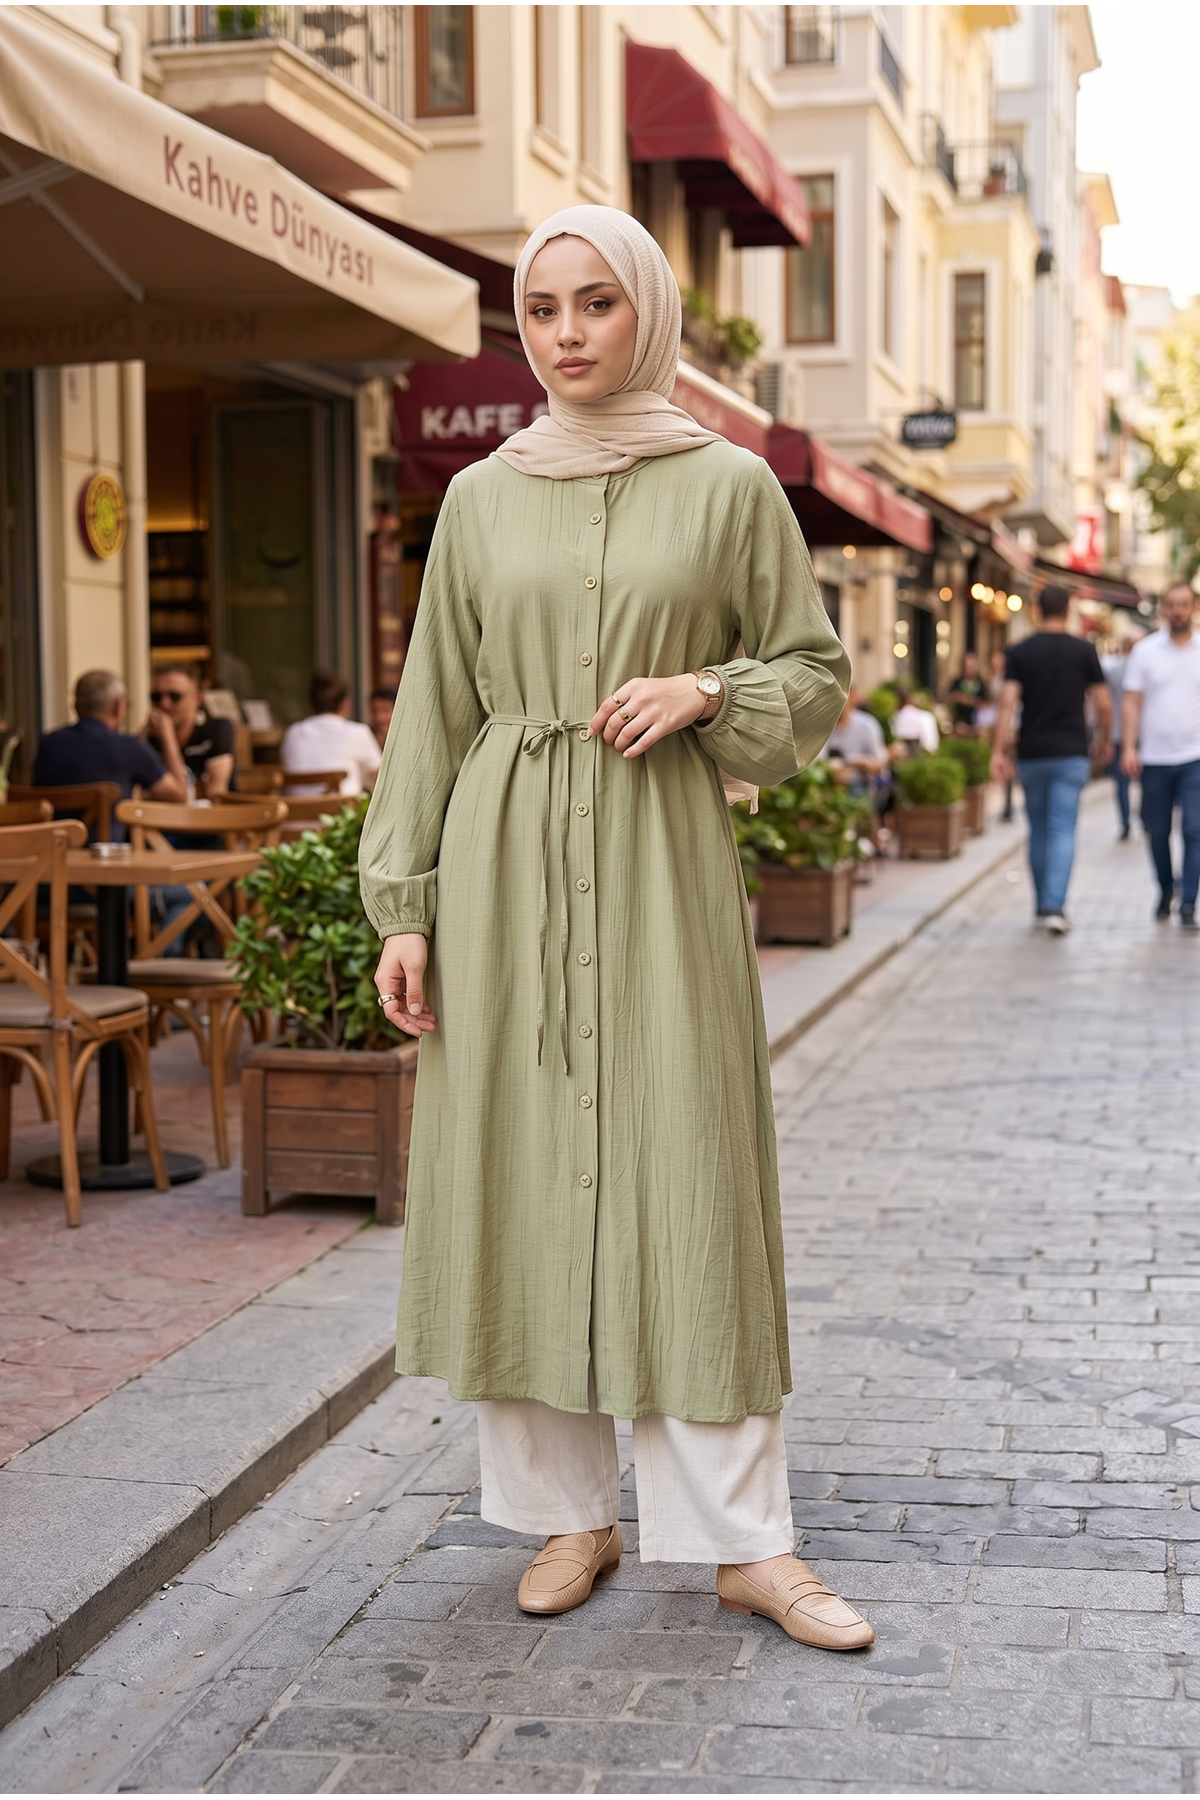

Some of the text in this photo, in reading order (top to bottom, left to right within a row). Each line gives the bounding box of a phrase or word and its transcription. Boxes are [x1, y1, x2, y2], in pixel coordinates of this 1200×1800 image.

[164, 134, 374, 286] Kahve Dünyası
[421, 404, 524, 440] KAFE
